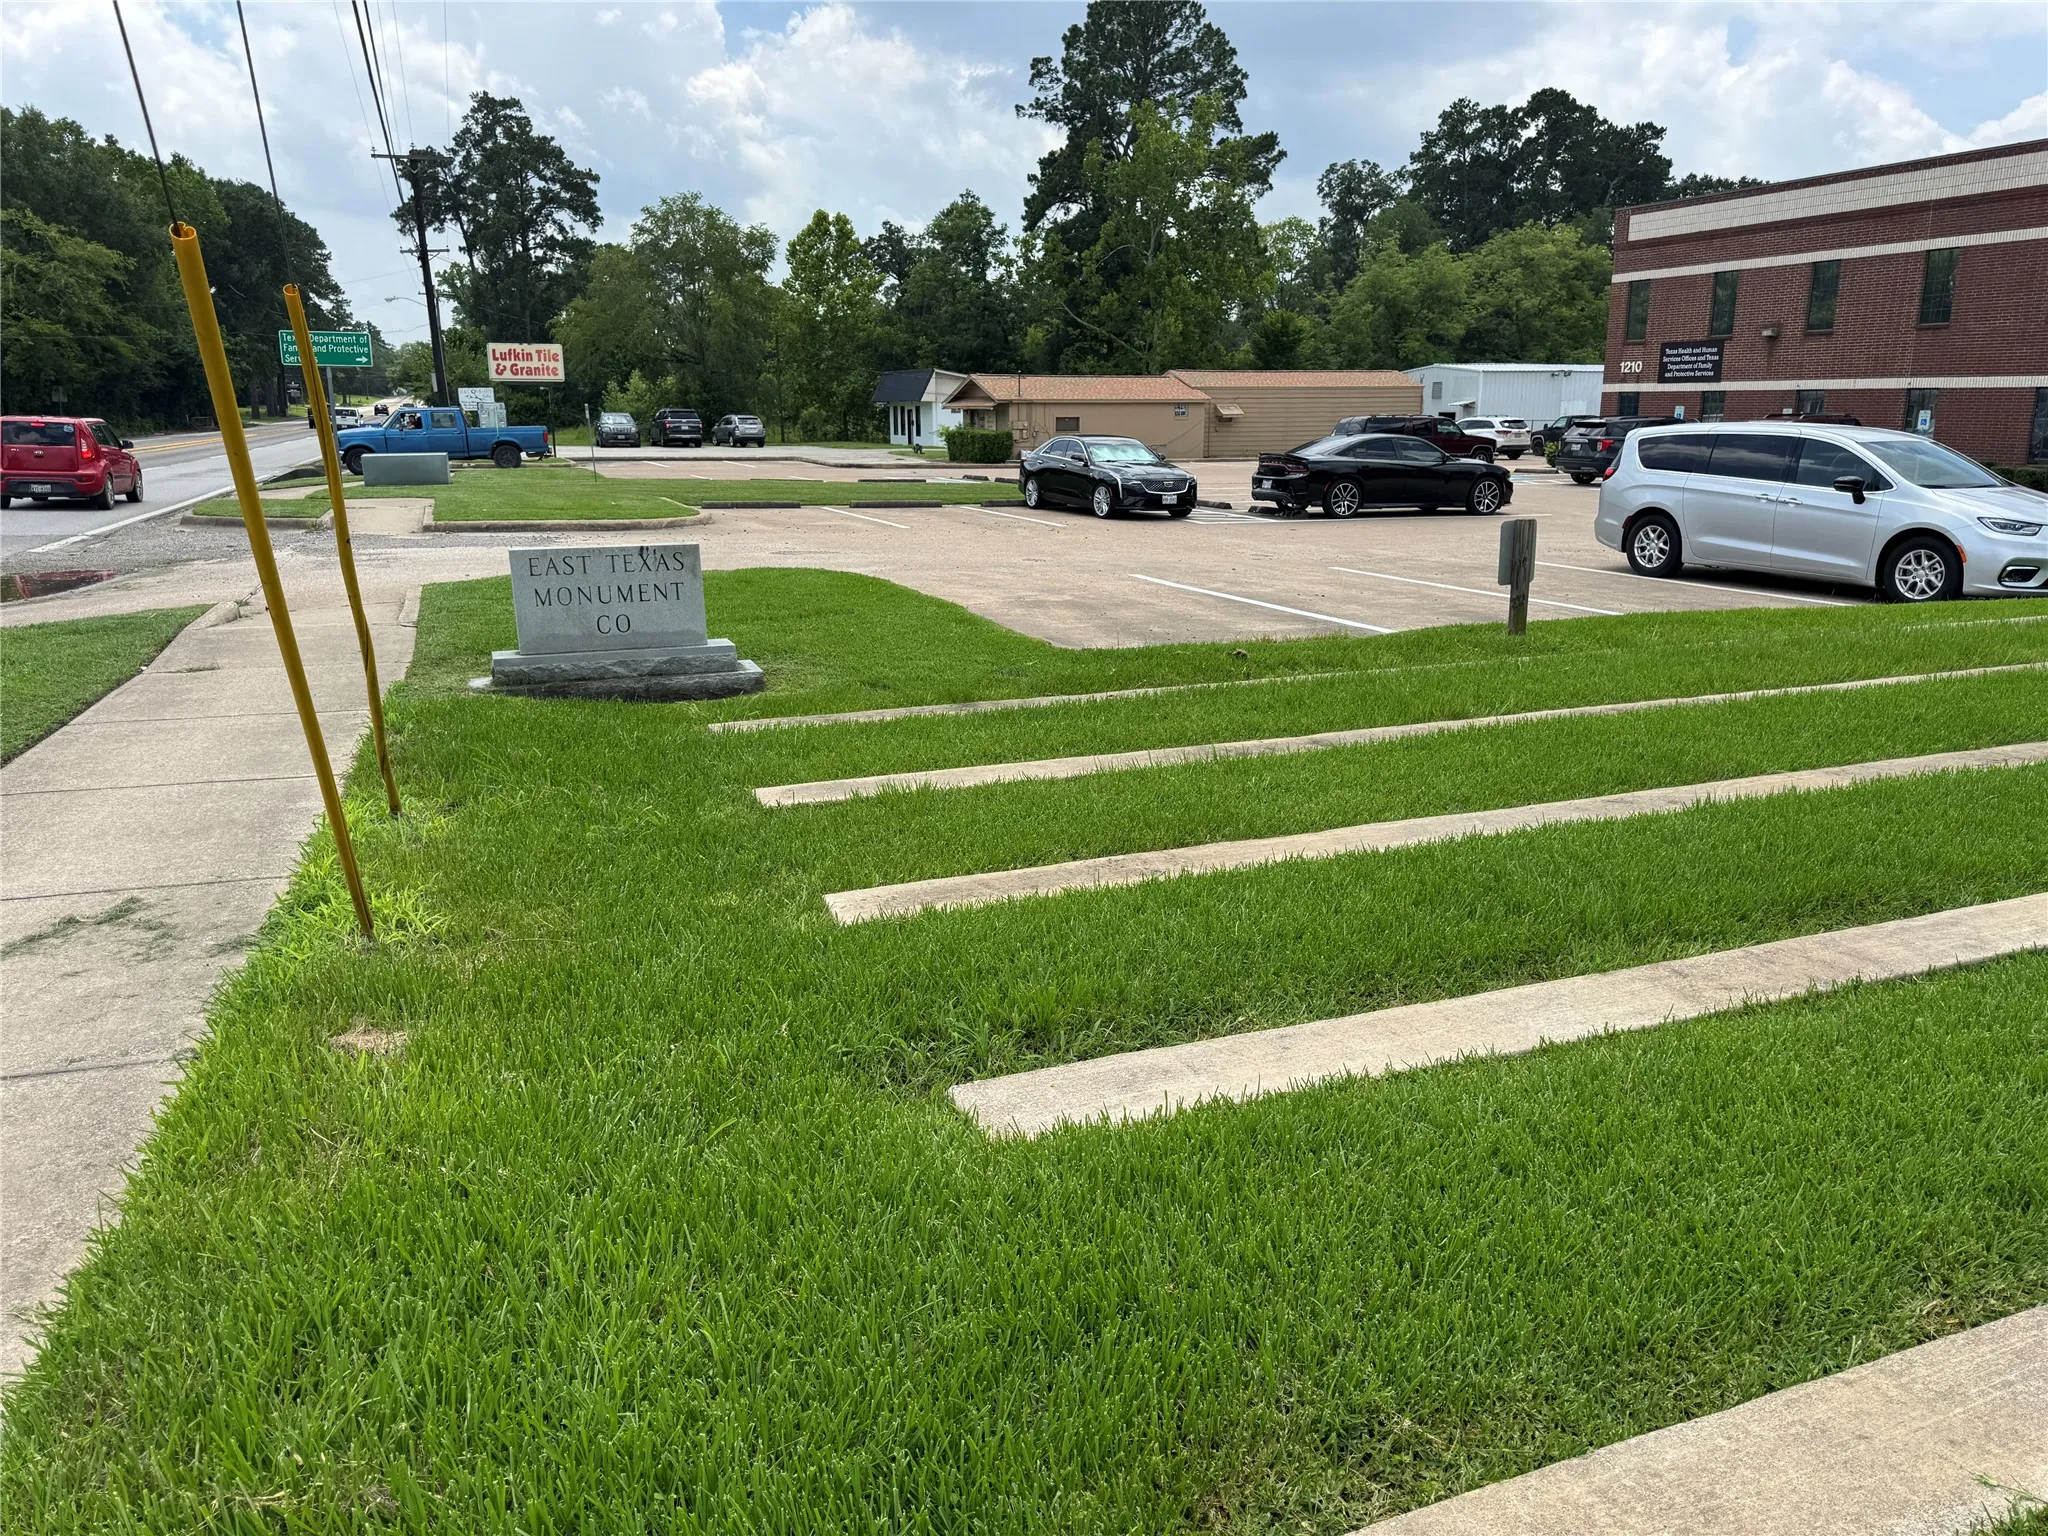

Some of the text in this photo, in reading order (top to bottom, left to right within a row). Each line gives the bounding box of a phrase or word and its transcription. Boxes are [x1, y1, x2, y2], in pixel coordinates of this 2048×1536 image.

[282, 333, 296, 341] Tex
[309, 334, 356, 343] Department
[313, 345, 327, 353] and
[328, 344, 369, 354] Protective
[492, 349, 560, 362] Lufkin Tile
[495, 363, 558, 376] & Granite
[1620, 361, 1643, 373] 1210
[528, 551, 685, 577] EAST TEXAS
[534, 582, 684, 608] MONUMENT
